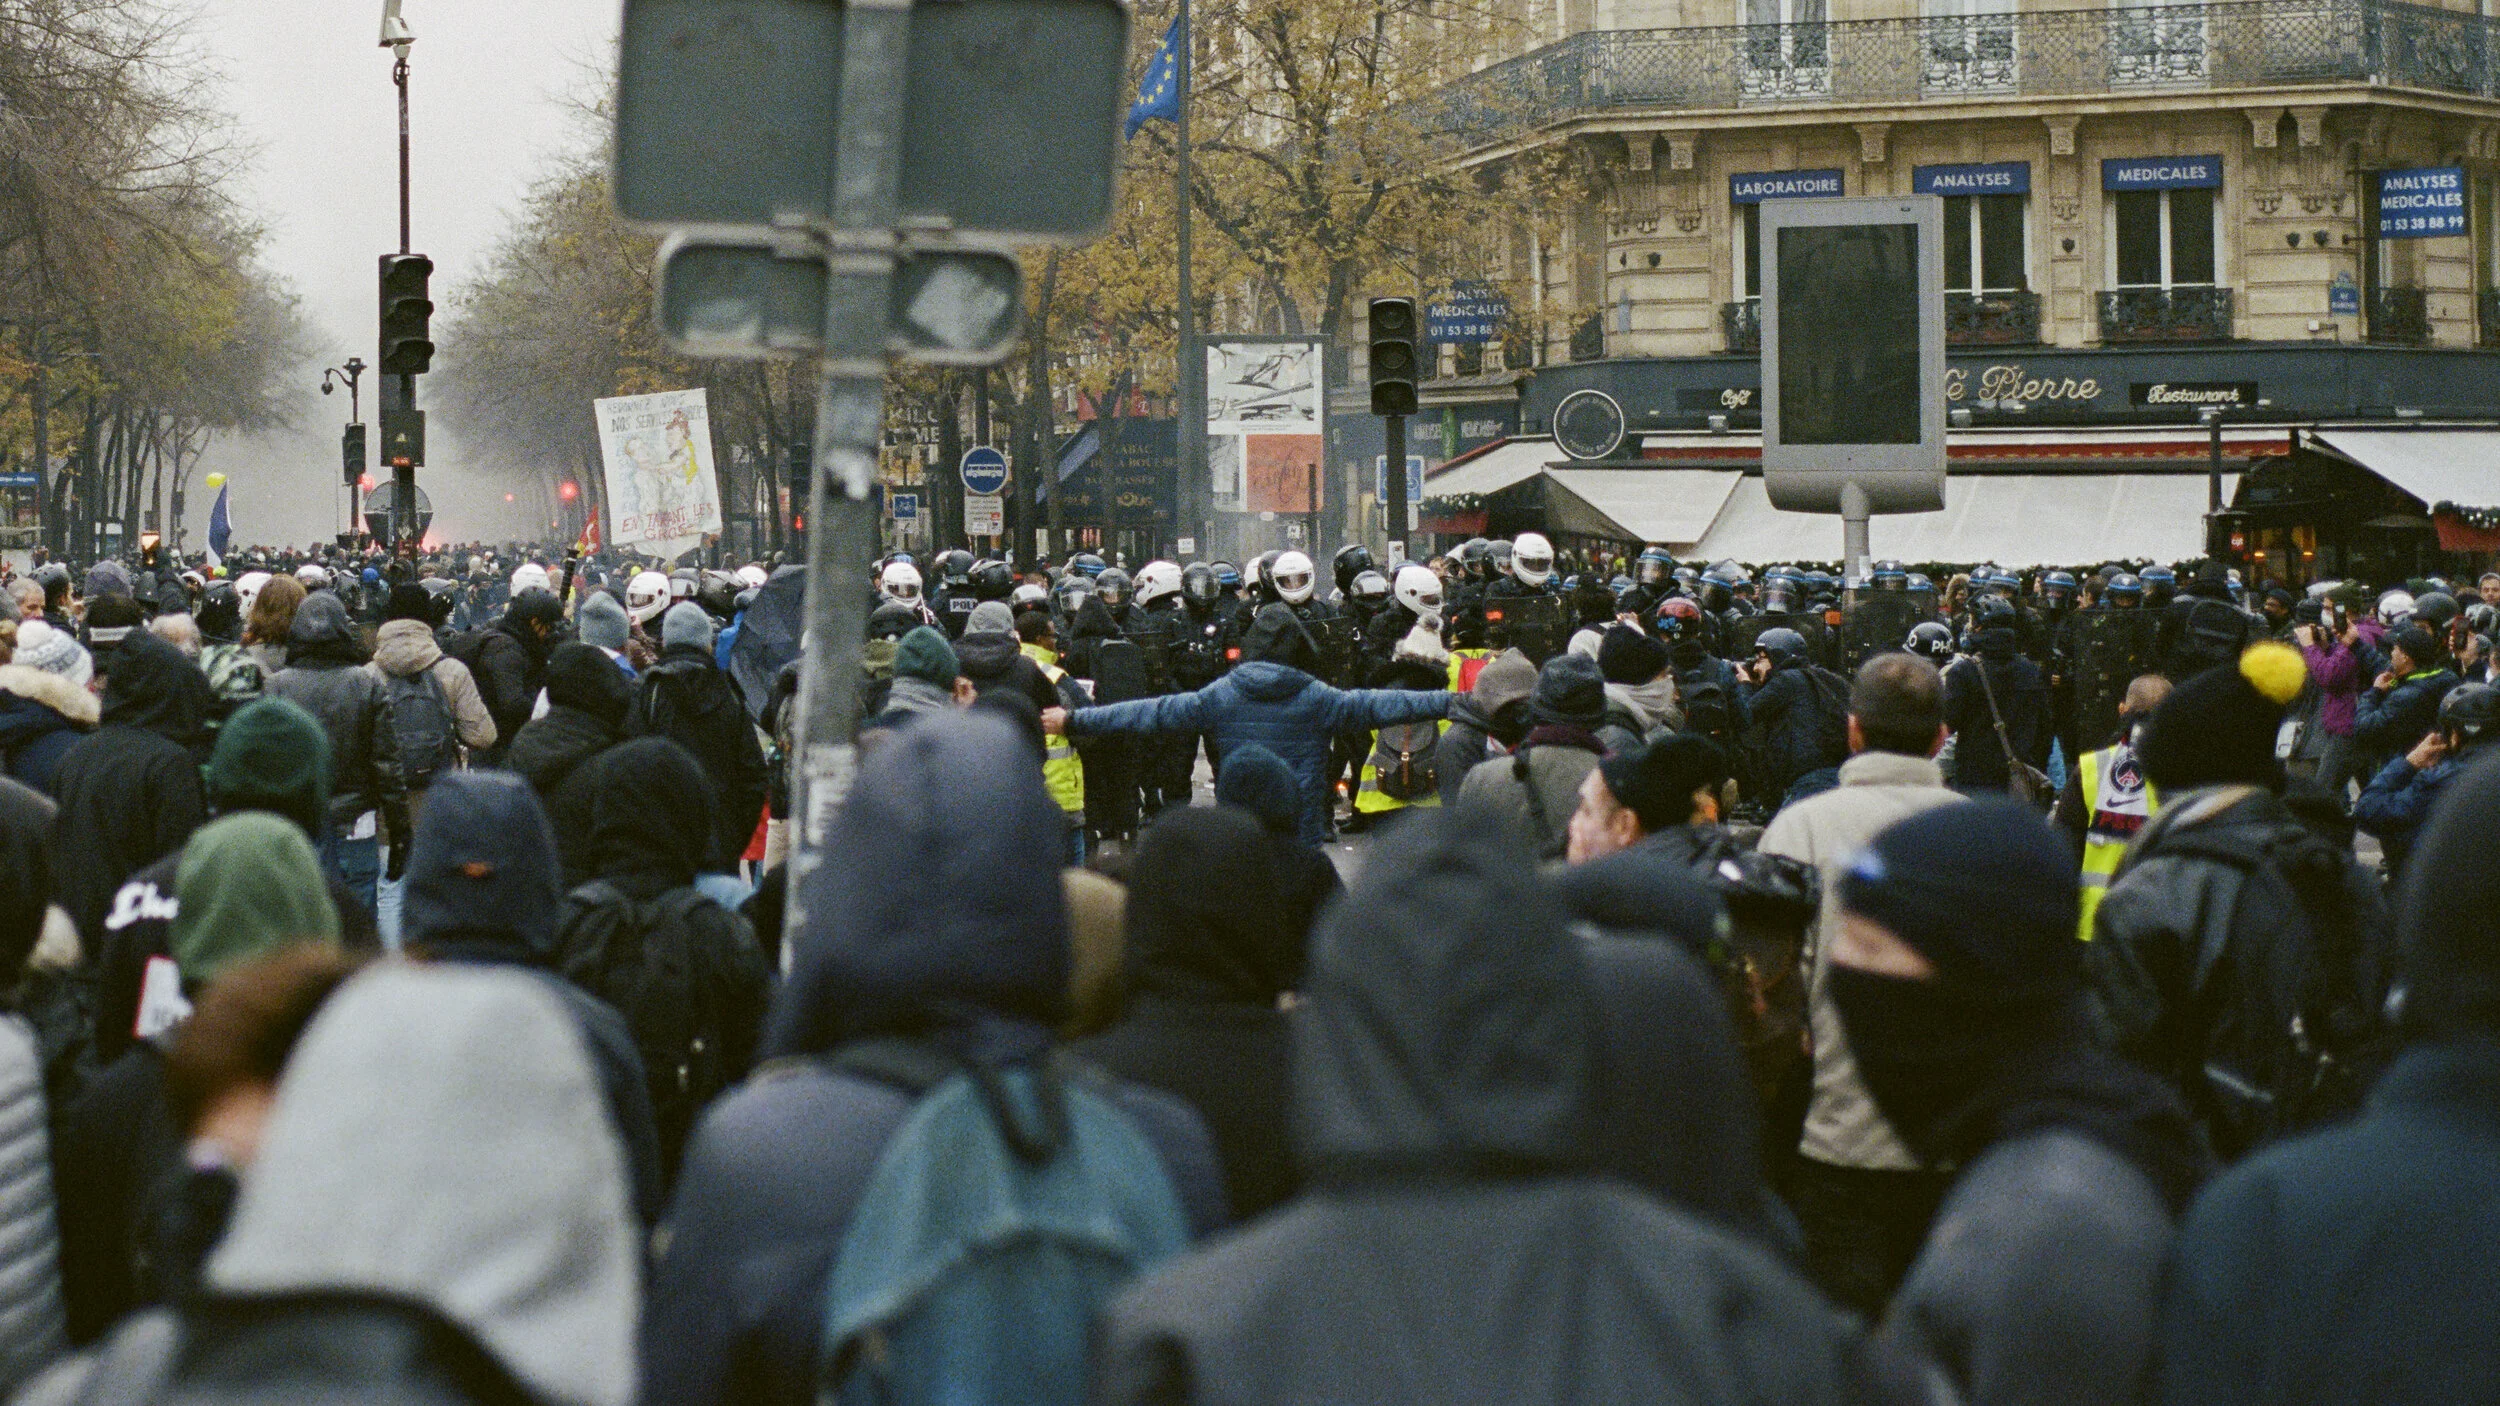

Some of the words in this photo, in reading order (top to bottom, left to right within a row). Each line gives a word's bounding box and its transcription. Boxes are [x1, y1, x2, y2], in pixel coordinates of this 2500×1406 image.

[1932, 173, 2011, 188] ANALYSES
[2118, 166, 2207, 182] MEDICALES
[2384, 174, 2458, 190] ANALYSES
[1735, 179, 1838, 196] LABORATOIRE
[2381, 193, 2463, 209] MEDICALES
[2381, 219, 2392, 231] 01
[2395, 218, 2408, 230] 53
[2411, 217, 2426, 229] 38
[2429, 217, 2445, 228] 88
[2448, 216, 2464, 228] 99
[1431, 304, 1507, 318] MEDICALES
[1430, 325, 1443, 337] 01
[1447, 325, 1461, 336] 53
[1463, 324, 1477, 336] 38
[1978, 365, 2102, 401] Pierre
[1721, 388, 1752, 409] Café
[2147, 384, 2240, 404] Restaurant
[611, 416, 630, 432] NOS
[622, 514, 639, 533] EN
[693, 503, 714, 521] LES
[643, 523, 688, 542] GROS
